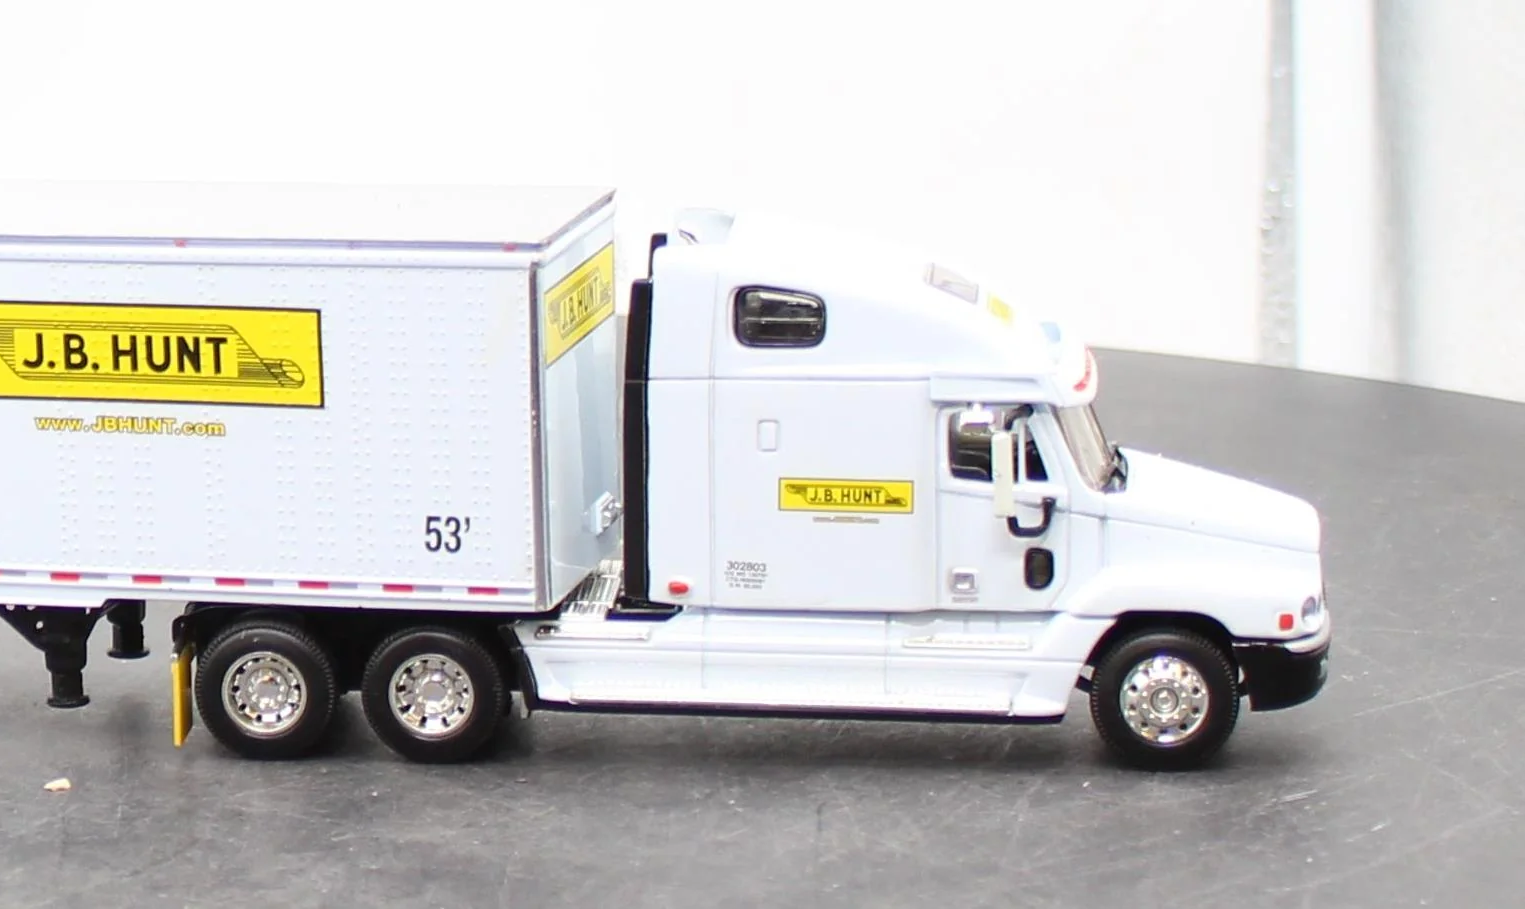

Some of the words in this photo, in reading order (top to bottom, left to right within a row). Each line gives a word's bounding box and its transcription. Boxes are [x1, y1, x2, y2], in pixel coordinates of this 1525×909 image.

[22, 332, 100, 370] J.B.
[111, 333, 228, 375] HUNT
[34, 415, 226, 437] www.JBHUNT.com
[841, 488, 882, 504] HUNT
[424, 514, 471, 553] 53'
